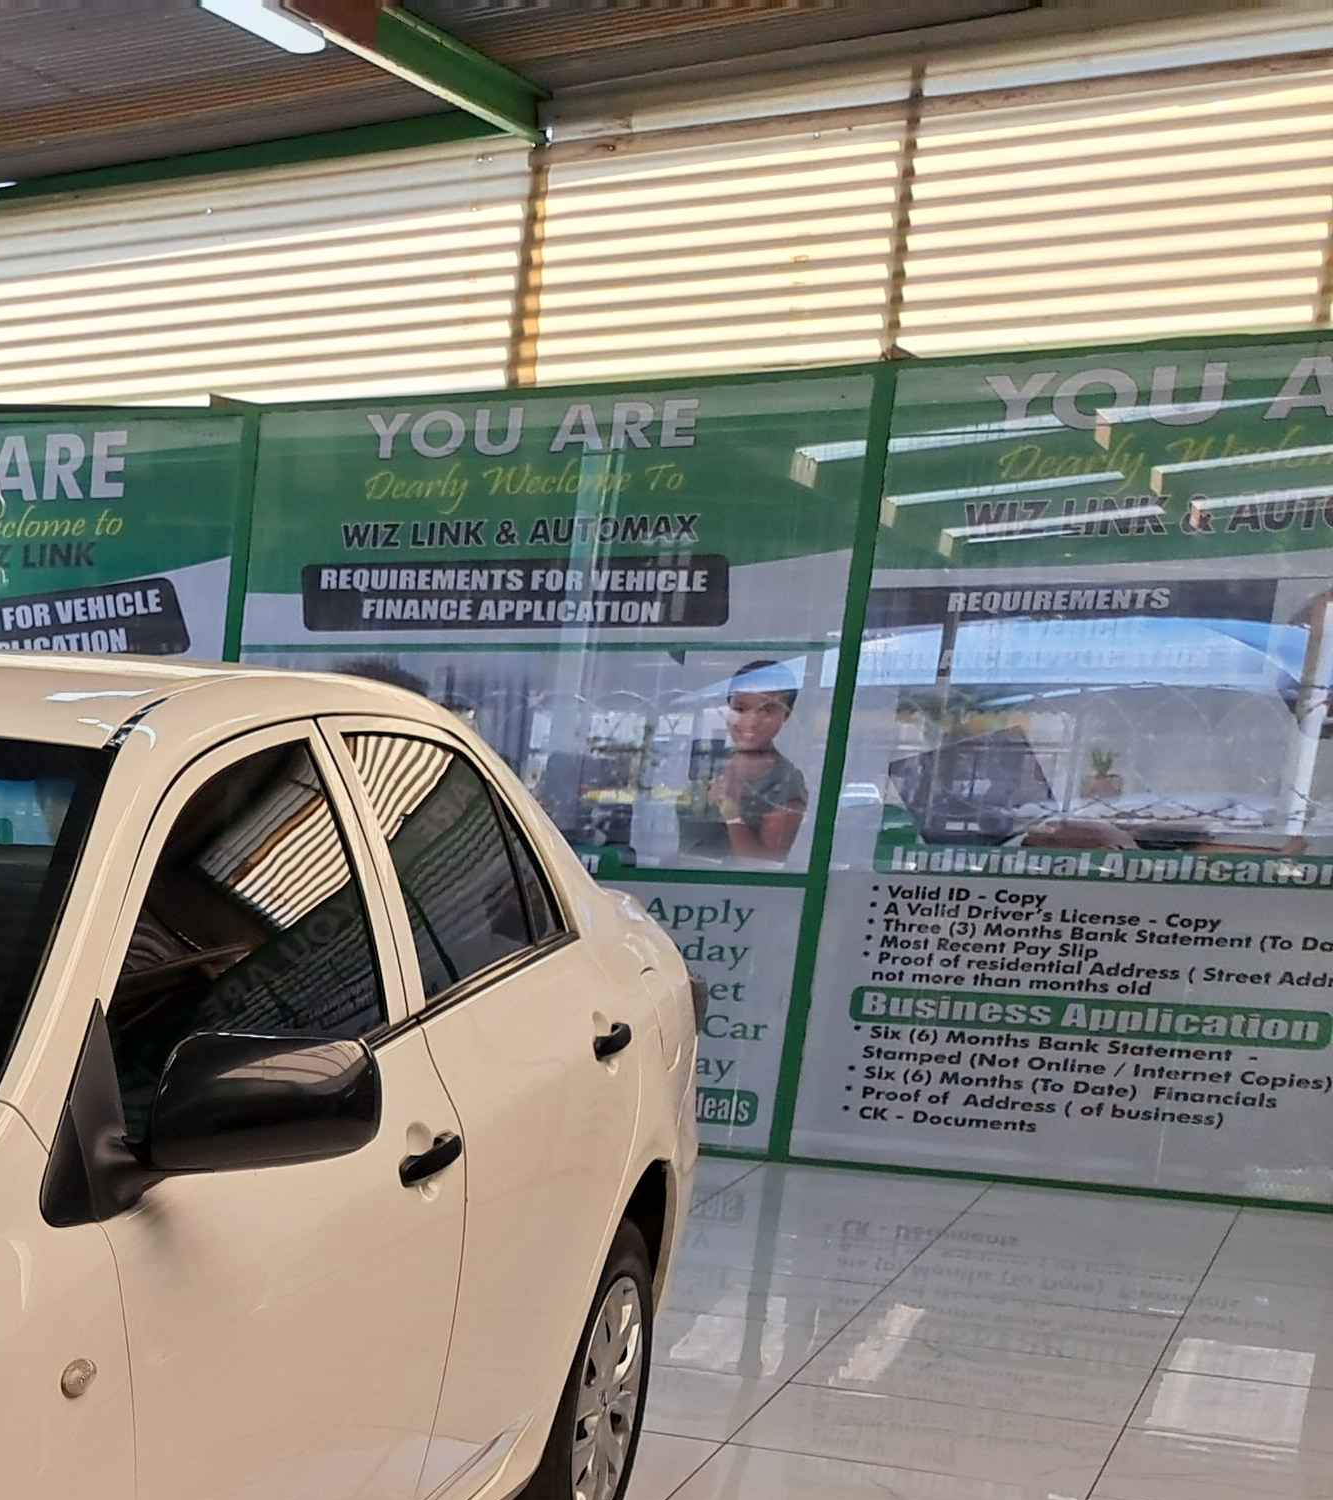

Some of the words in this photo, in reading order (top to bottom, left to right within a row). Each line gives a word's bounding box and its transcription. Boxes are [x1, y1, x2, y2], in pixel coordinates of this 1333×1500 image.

[985, 362, 1229, 430] YOU
[366, 407, 525, 460] YOU
[549, 398, 699, 453] ARE
[365, 463, 468, 515] Dearly
[644, 462, 686, 491] To
[95, 508, 123, 537] to
[341, 521, 404, 551] WIZ
[409, 519, 487, 549] LINK
[494, 519, 520, 547] &
[528, 512, 701, 546] AUTOMAX
[21, 541, 95, 569] LINK
[320, 568, 524, 593] REQUIREMENTS
[532, 568, 585, 593] FOR
[591, 568, 708, 593] VEHICLE
[1, 599, 51, 632] FOR
[56, 588, 163, 625] VEHICLE
[362, 598, 475, 622] FINANCE
[478, 599, 664, 625] APPLICATION
[947, 587, 1171, 614] REQUIREMENTS
[890, 846, 1093, 877] Individual
[888, 885, 941, 902] Valid
[948, 887, 971, 902] ID
[995, 889, 1048, 909] Copy
[646, 897, 755, 933] Apply
[884, 902, 899, 916] A
[907, 903, 960, 920] Valid
[967, 905, 1053, 924] Driver's
[1061, 909, 1140, 927] License
[1166, 913, 1222, 933] Copy
[880, 935, 929, 950] Most
[937, 938, 1006, 955] Recent
[1013, 942, 1051, 959] Pay
[1058, 943, 1099, 962] Slip
[883, 918, 942, 935] Three
[949, 921, 977, 939] (3)
[984, 924, 1063, 941] Months
[1070, 926, 1128, 943] Bank
[1135, 929, 1253, 949] Statement
[1260, 935, 1293, 953] (To
[871, 970, 905, 983] not
[912, 973, 966, 986] more
[973, 972, 1021, 988] than
[1029, 976, 1109, 994] months
[1117, 980, 1153, 996] old
[878, 951, 933, 967] Proof
[940, 954, 961, 968] of
[967, 956, 1083, 975] residential
[1089, 962, 1181, 980] Address
[1203, 967, 1271, 985] Street
[702, 1014, 768, 1041] Car
[861, 990, 1053, 1026] Business
[1060, 1002, 1319, 1042] Application
[870, 1025, 901, 1041] Six
[909, 1027, 938, 1046] (6)
[945, 1030, 1030, 1049] Months
[1038, 1036, 1099, 1053] Bank
[1107, 1040, 1233, 1062] Statement
[862, 1045, 962, 1066] Stamped
[970, 1052, 1020, 1070] (Not
[1027, 1056, 1107, 1076] Online
[1133, 1063, 1233, 1083] Internet
[1240, 1071, 1332, 1093] Copies)
[864, 1065, 895, 1081] Six
[903, 1068, 932, 1086] (6)
[939, 1071, 1024, 1090] Months
[1031, 1077, 1064, 1095] (To
[1073, 1081, 1137, 1101] Date)
[1153, 1086, 1278, 1110] Financials
[859, 1106, 889, 1122] CK
[912, 1110, 1038, 1134] Documents
[862, 1086, 921, 1102] Proof
[928, 1090, 951, 1105] of
[962, 1093, 1057, 1114] Address
[1080, 1102, 1104, 1118] of
[1111, 1104, 1225, 1130] business)
